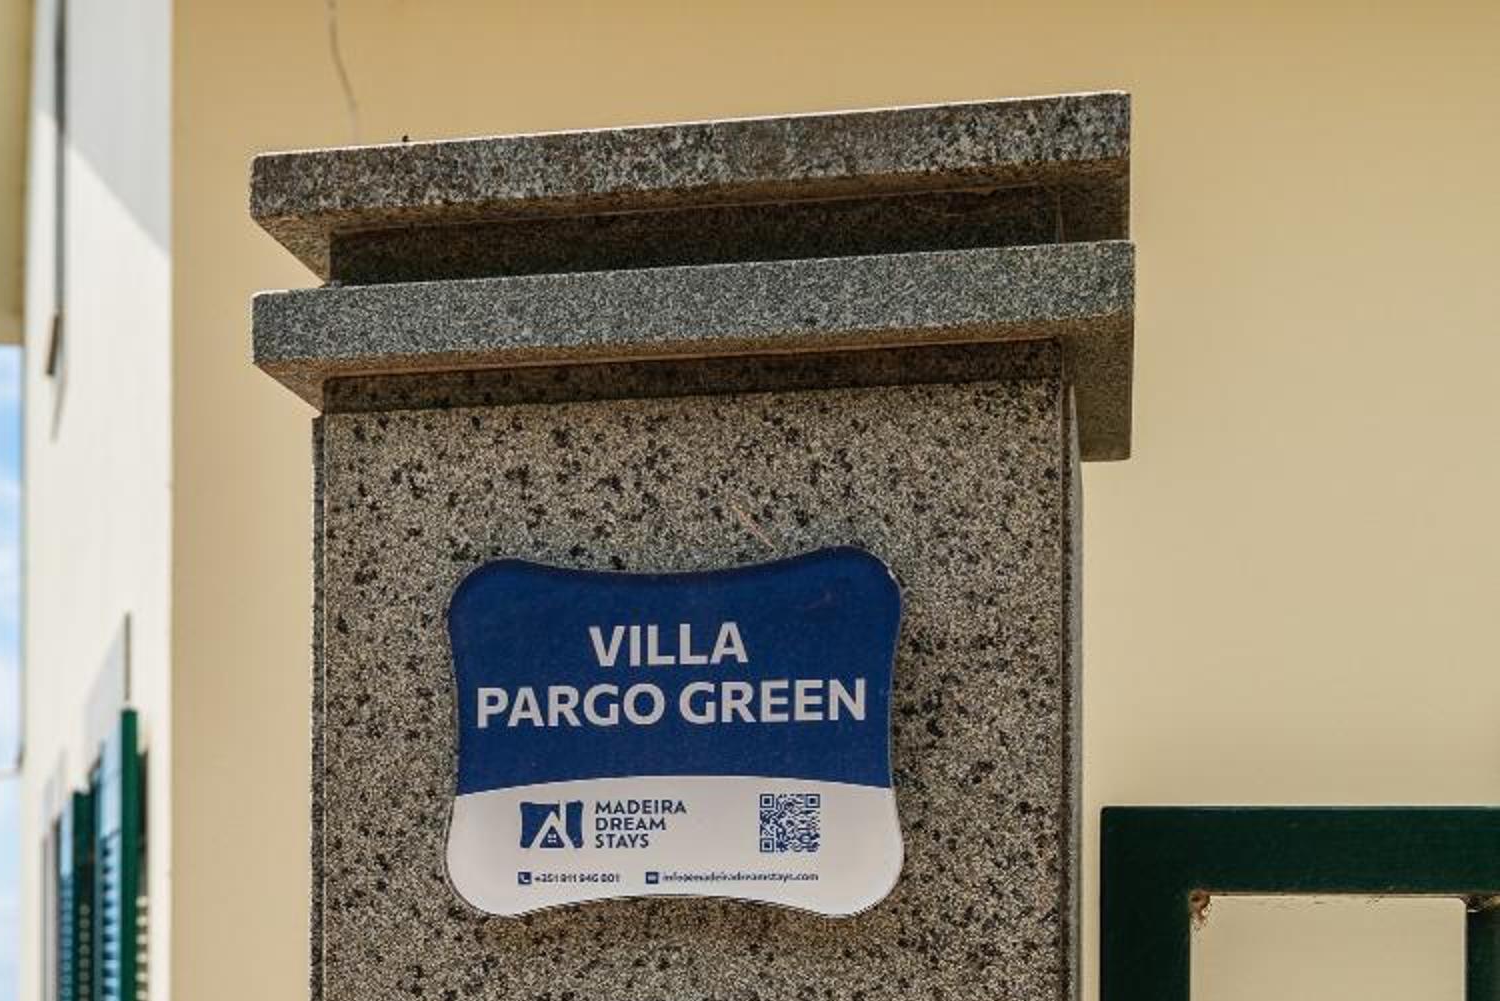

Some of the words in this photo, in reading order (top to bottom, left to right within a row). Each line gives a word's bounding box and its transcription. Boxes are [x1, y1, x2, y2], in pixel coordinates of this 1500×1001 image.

[588, 621, 749, 667] VILLA
[476, 683, 666, 729] PARGO
[679, 677, 867, 725] GREEN
[594, 799, 687, 815] MADEIRA
[595, 817, 667, 831] DREAM
[595, 833, 649, 849] STAYS
